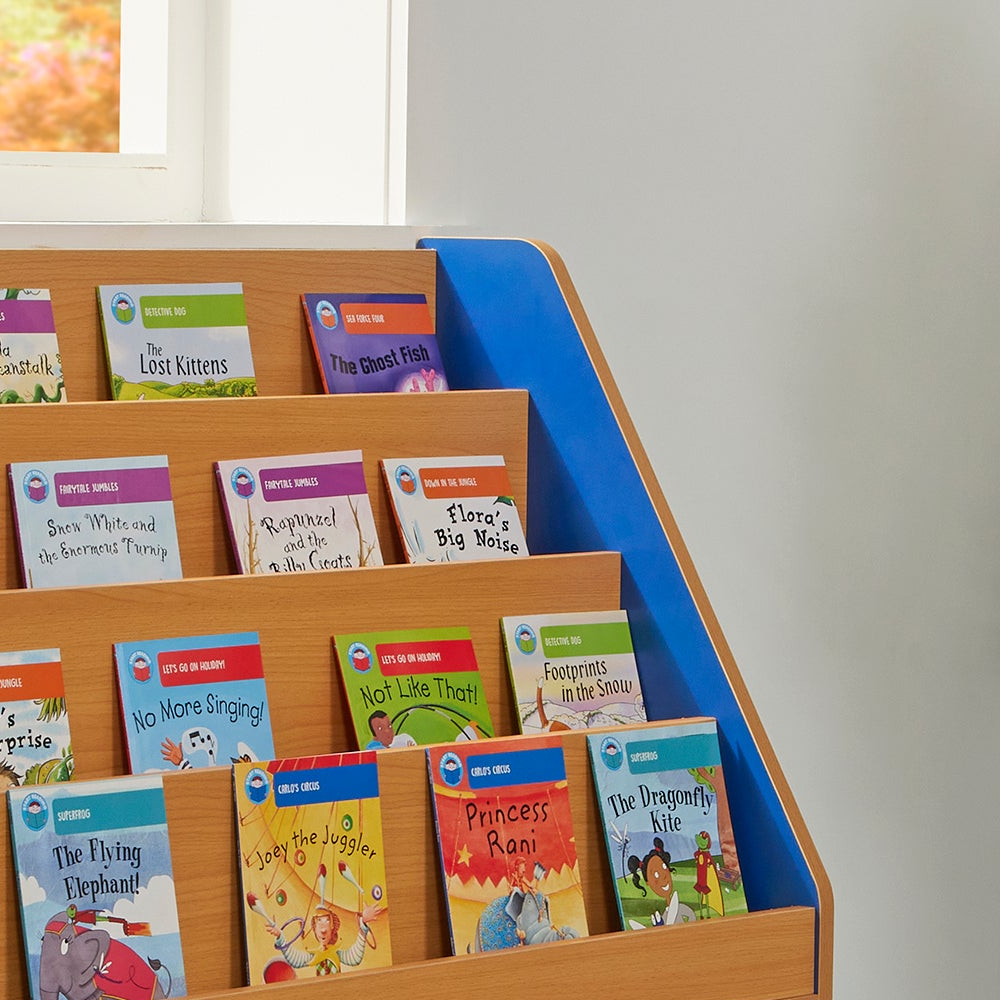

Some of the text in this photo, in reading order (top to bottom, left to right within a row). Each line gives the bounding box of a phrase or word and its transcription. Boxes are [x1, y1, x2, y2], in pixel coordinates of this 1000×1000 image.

[144, 307, 187, 317] DETECTIVE DOG
[346, 314, 385, 323] SEA FORCE FOUR
[146, 343, 163, 356] The
[330, 344, 430, 375] The Ghost Fish
[140, 353, 228, 376] Lost Kittens
[60, 482, 119, 494] FAIRYTALE JUMBLES
[264, 477, 319, 490] FAIRYTALE JUMBLES
[424, 478, 440, 488] DOWN
[448, 478, 458, 486] THE
[459, 478, 477, 486] JUNGLE
[47, 513, 157, 537] Snow White and
[260, 506, 337, 539] Rapunzel
[446, 503, 509, 531] Flora's
[38, 538, 168, 565] the Enormous Turnip
[283, 531, 328, 553] and the
[434, 528, 519, 555] Big Noise
[545, 636, 582, 646] DETECTIVE DOG
[162, 660, 225, 674] LET'S GO ON HOLIDAY!
[381, 655, 396, 664] LET'S
[397, 654, 406, 663] GO
[407, 654, 416, 663] ON
[544, 660, 608, 683] Footprints
[0, 678, 23, 689] JUNGLE
[360, 676, 478, 709] Not Like That!
[562, 678, 633, 702] in the Snow
[132, 693, 264, 734] No More Singing!
[630, 751, 658, 763] SUPERFROG
[471, 764, 511, 777] CARLO'S CIRCUS
[278, 781, 320, 795] CARLO'S CIRCUS
[608, 784, 714, 819] The Dragonfly
[57, 808, 91, 822] SUPERFROG
[466, 801, 548, 831] Princess
[650, 810, 682, 833] Kite
[52, 838, 142, 870] The Flying
[256, 825, 377, 871] Joey the Juggler
[487, 829, 536, 858] Rani
[64, 872, 140, 903] Elephant!
